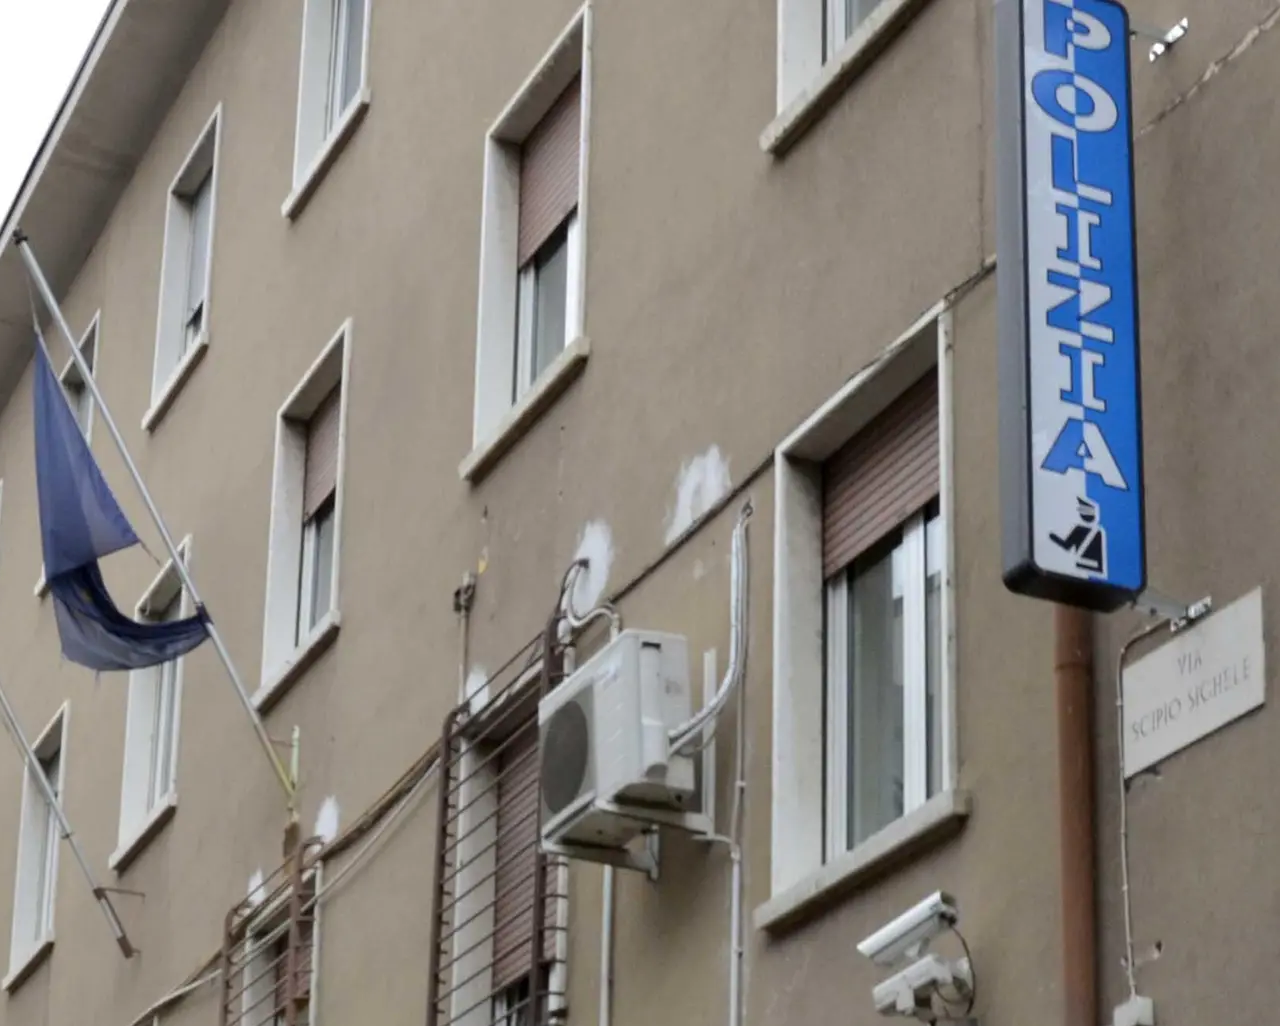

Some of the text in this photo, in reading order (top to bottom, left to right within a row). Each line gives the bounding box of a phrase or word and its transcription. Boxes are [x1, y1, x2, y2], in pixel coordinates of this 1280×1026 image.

[1031, 0, 1128, 491] POLIZIA
[1131, 654, 1252, 742] SCIPIO SIGHELE
[1177, 651, 1203, 676] VIA
